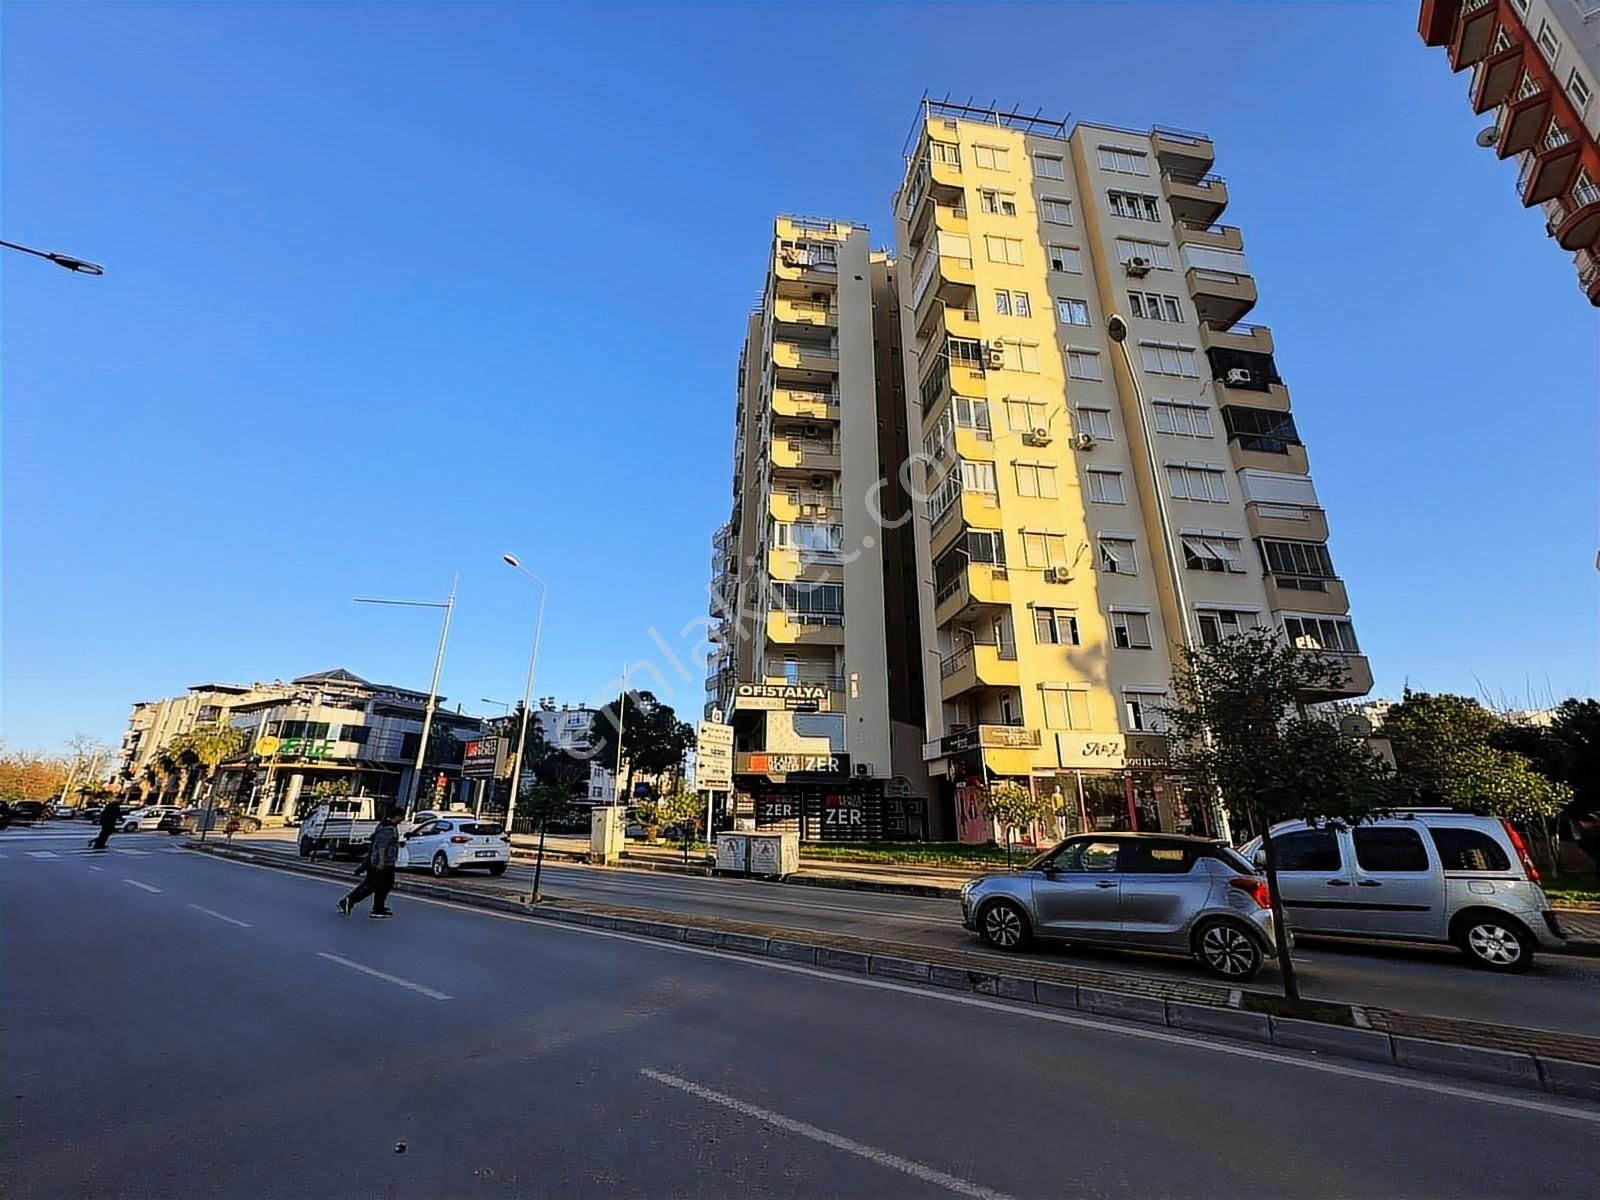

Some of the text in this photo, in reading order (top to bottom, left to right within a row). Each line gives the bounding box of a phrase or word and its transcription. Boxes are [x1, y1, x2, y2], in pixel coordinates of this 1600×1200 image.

[805, 756, 839, 772] ZER
[765, 804, 792, 816] ZER
[825, 808, 862, 825] ZER
